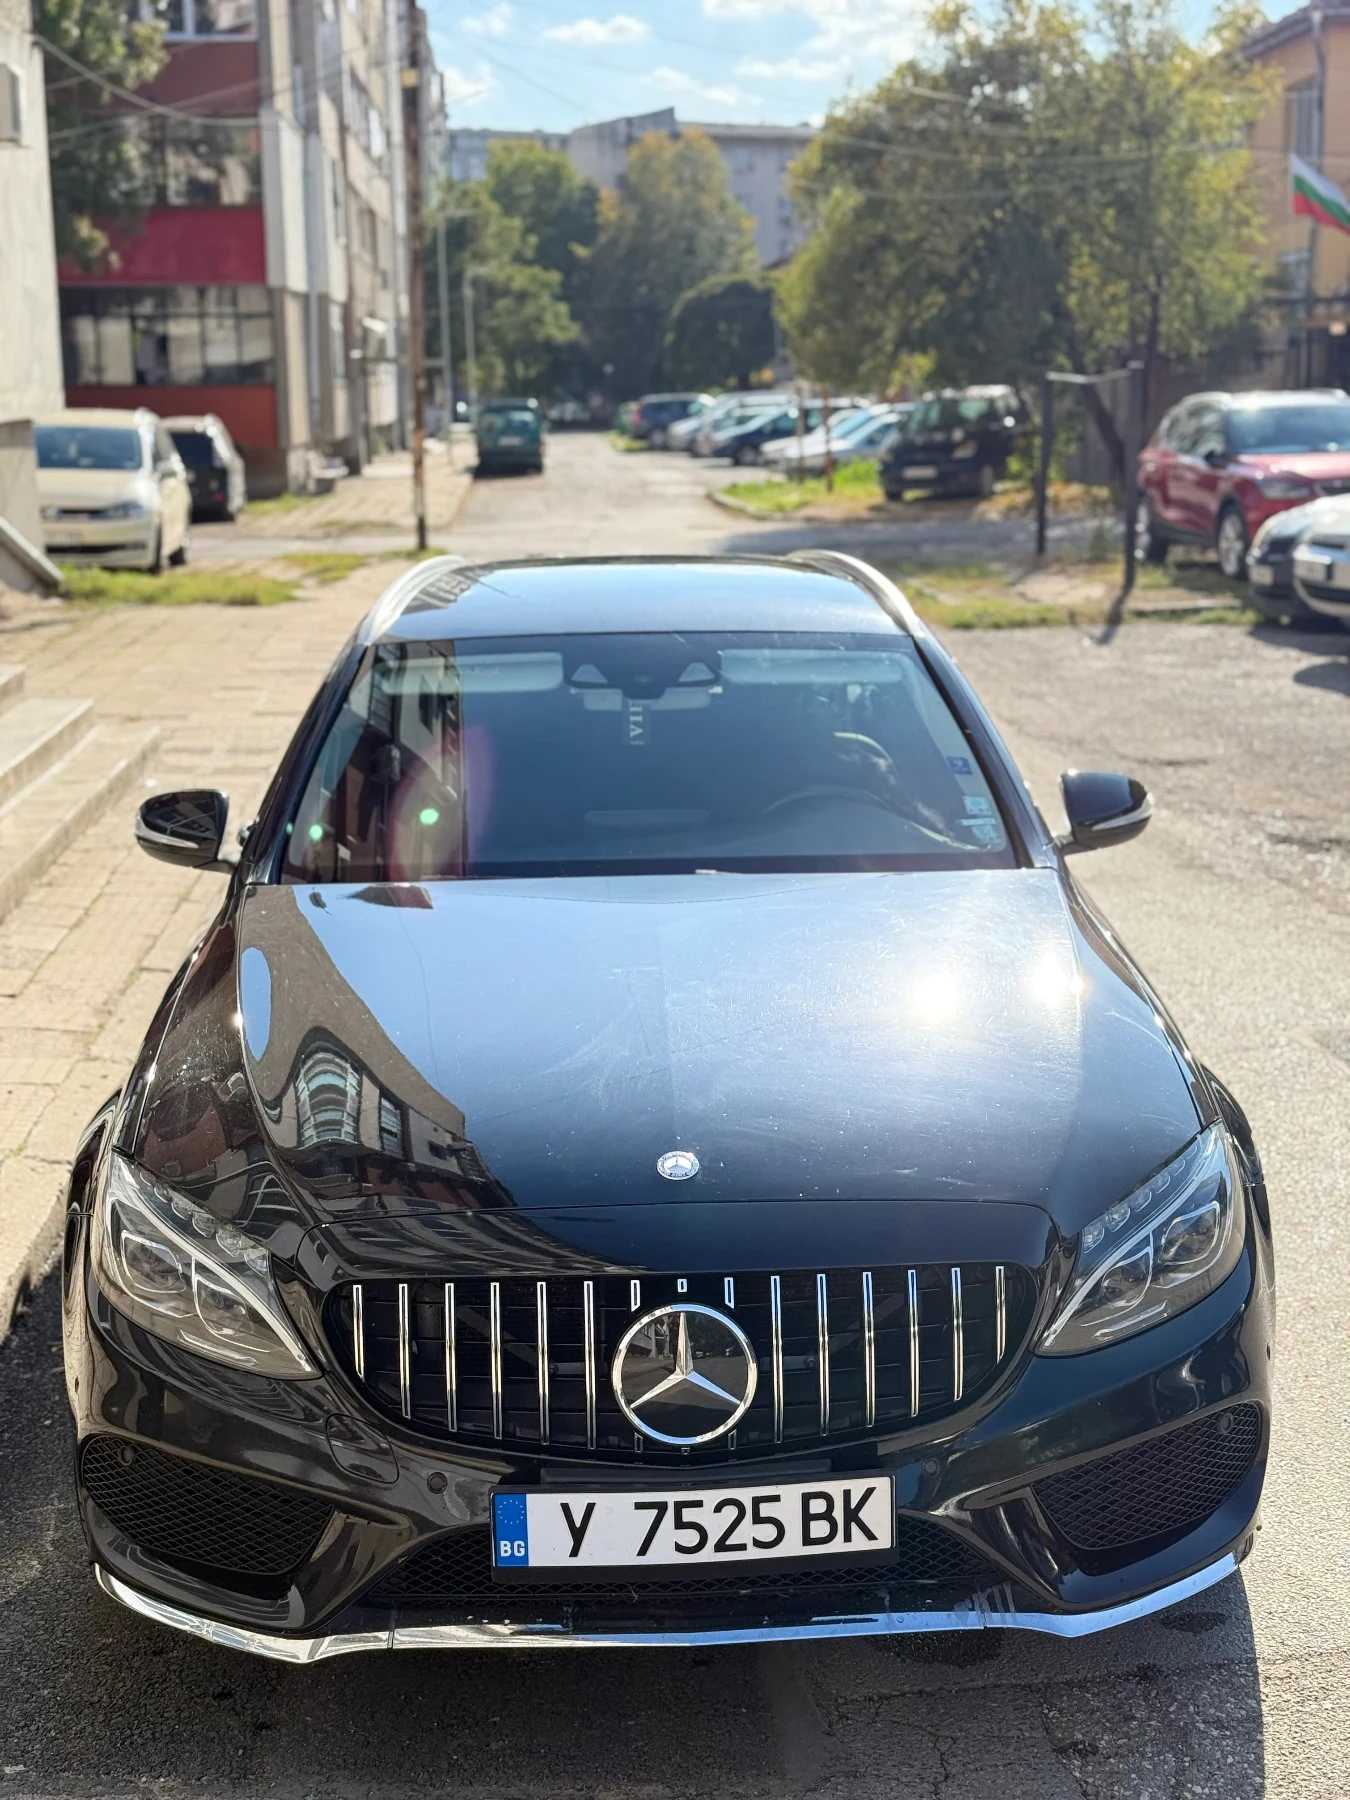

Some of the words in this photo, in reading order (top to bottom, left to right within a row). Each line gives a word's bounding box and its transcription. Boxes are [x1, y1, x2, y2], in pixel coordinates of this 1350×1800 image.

[634, 1494, 785, 1556] 7525
[802, 1487, 878, 1546] BK
[500, 1541, 526, 1557] BG
